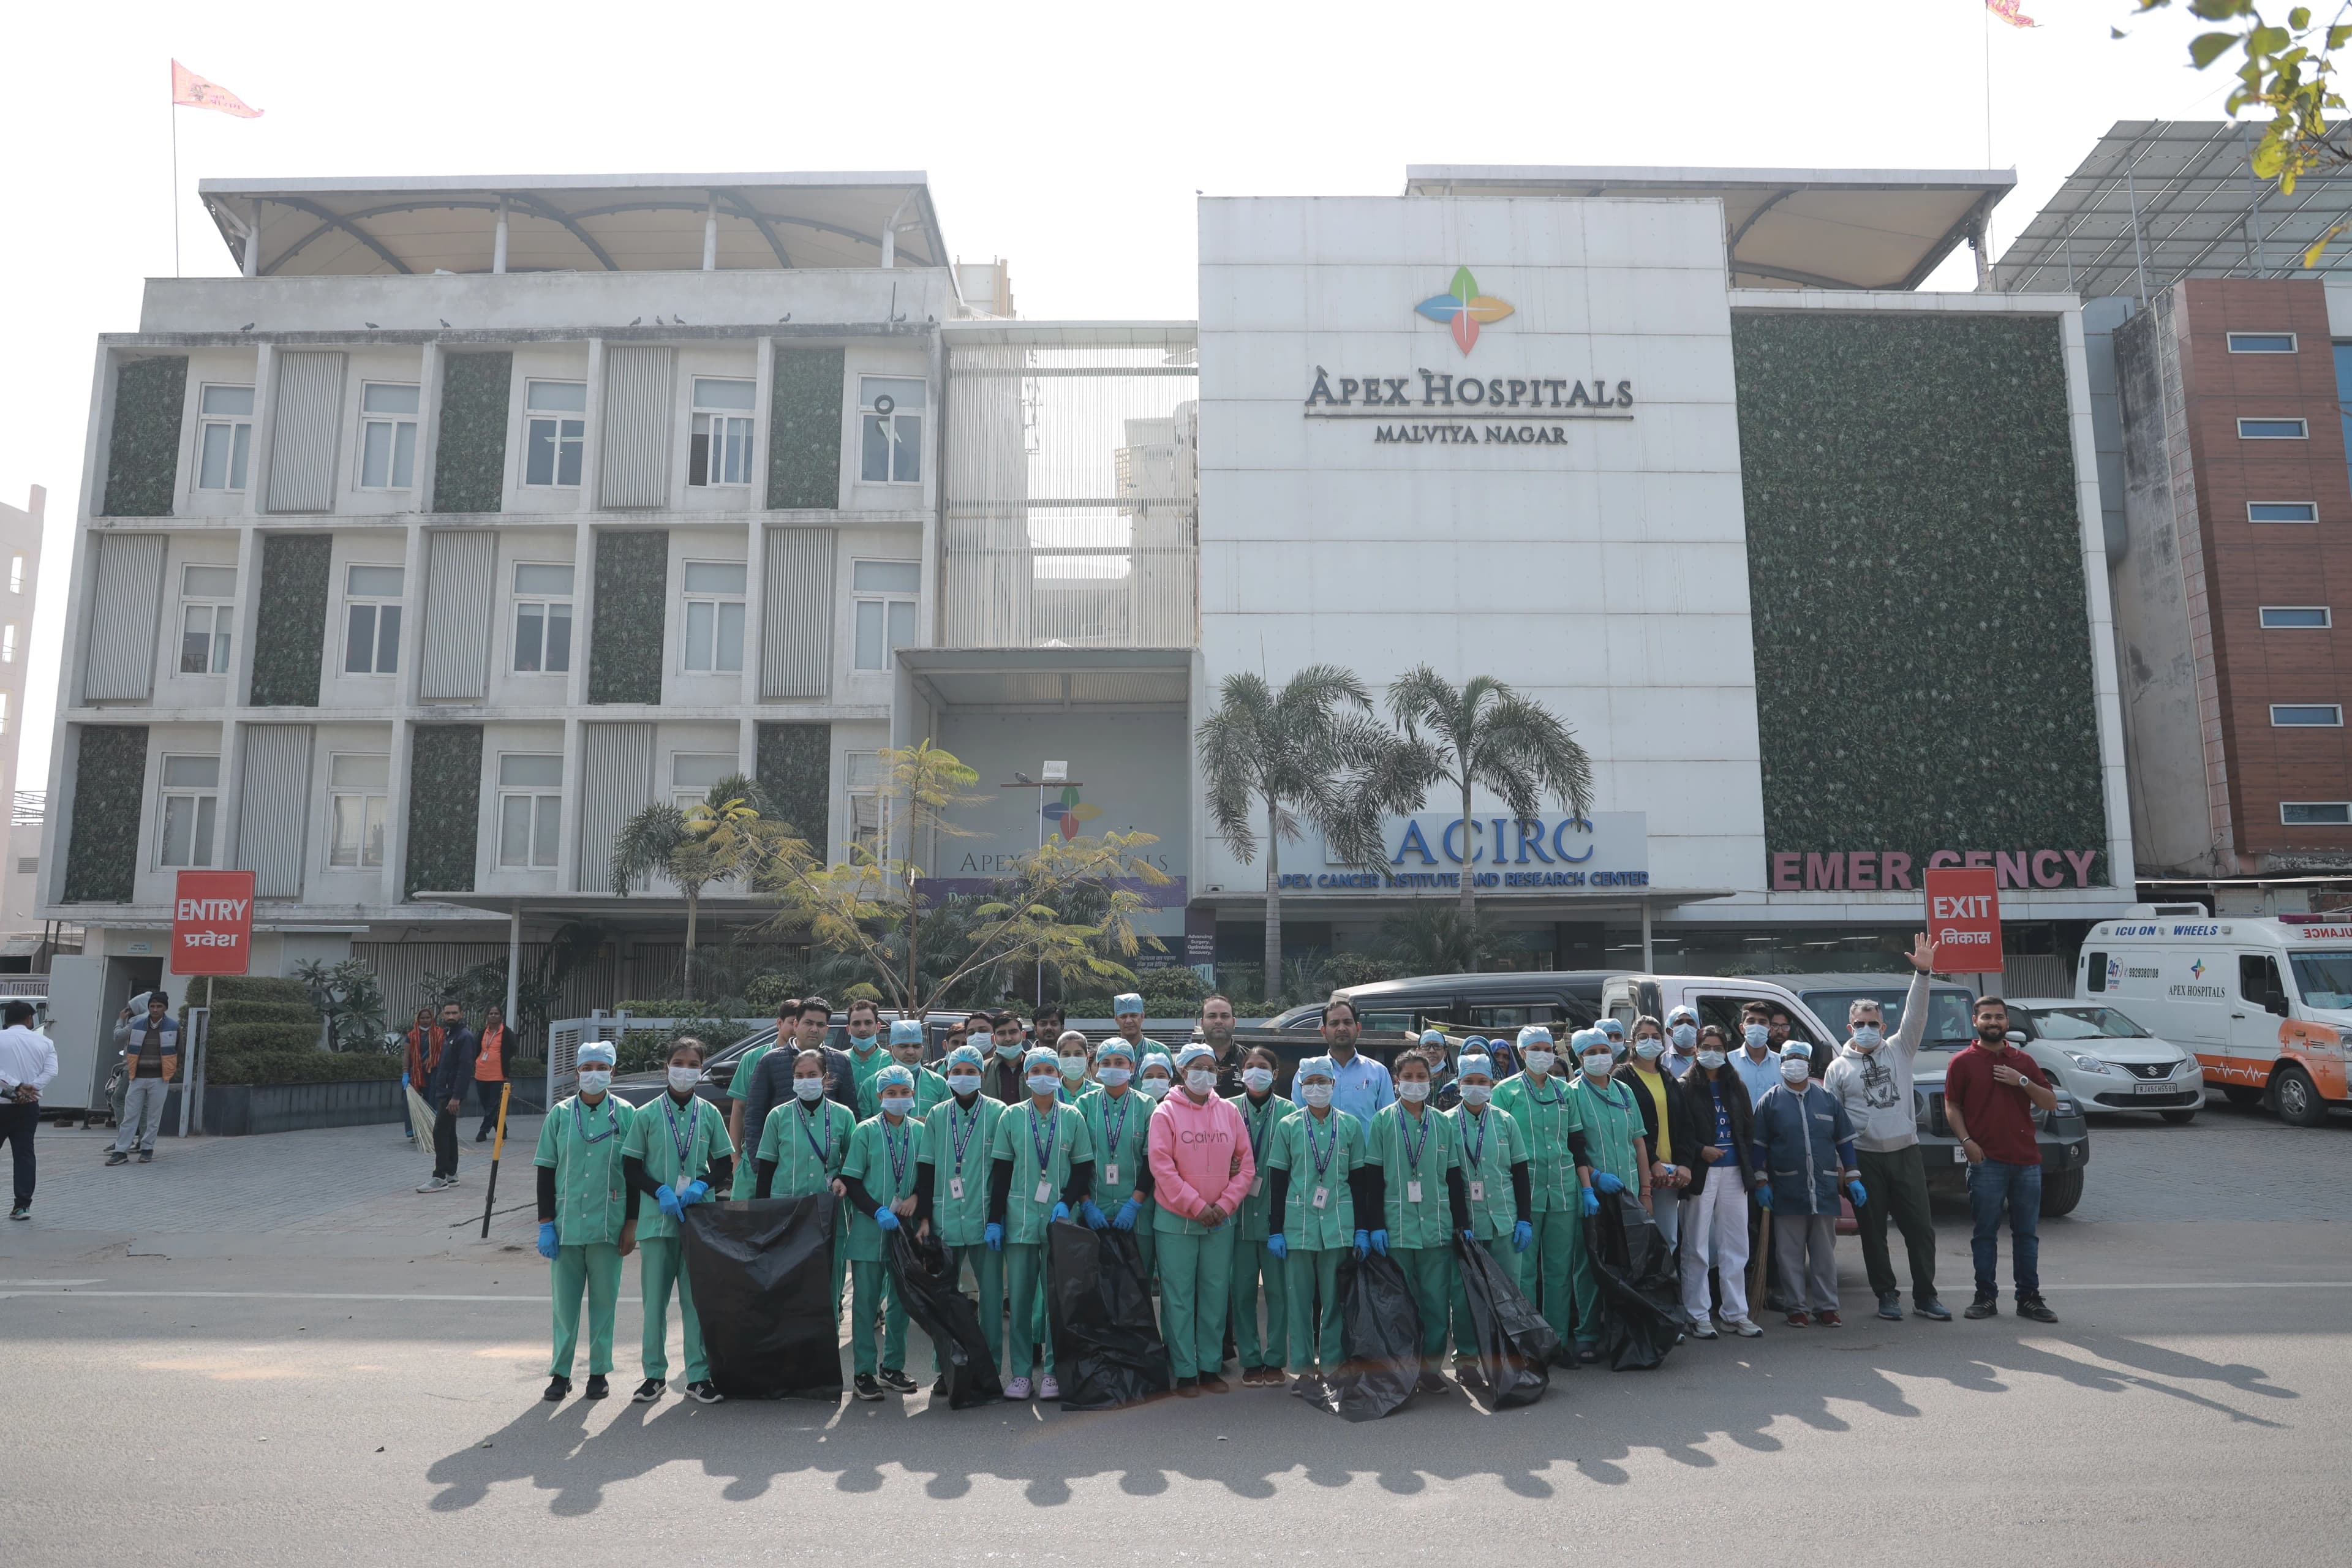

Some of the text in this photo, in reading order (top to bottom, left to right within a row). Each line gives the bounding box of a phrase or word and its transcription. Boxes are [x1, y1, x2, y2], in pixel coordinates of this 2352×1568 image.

[1305, 373, 1634, 408] APEX HOSPITALS
[1374, 425, 1568, 445] MALVIYA NAGAR
[1390, 818, 1594, 864] ACIRC
[1317, 874, 1379, 888] CANCER
[1506, 872, 1586, 887] RESEARCH
[1590, 871, 1649, 886] CENTER
[178, 899, 249, 921] ENTRY
[1933, 895, 1992, 919] EXIT
[184, 930, 238, 947] प्रवेश
[1940, 928, 1991, 946] निकास
[2115, 925, 2218, 936] ICU ON WHEELS
[2128, 968, 2158, 978] 9929380108
[2168, 985, 2225, 998] APEX HOSPITALS
[1181, 1131, 1229, 1143] Calvin
